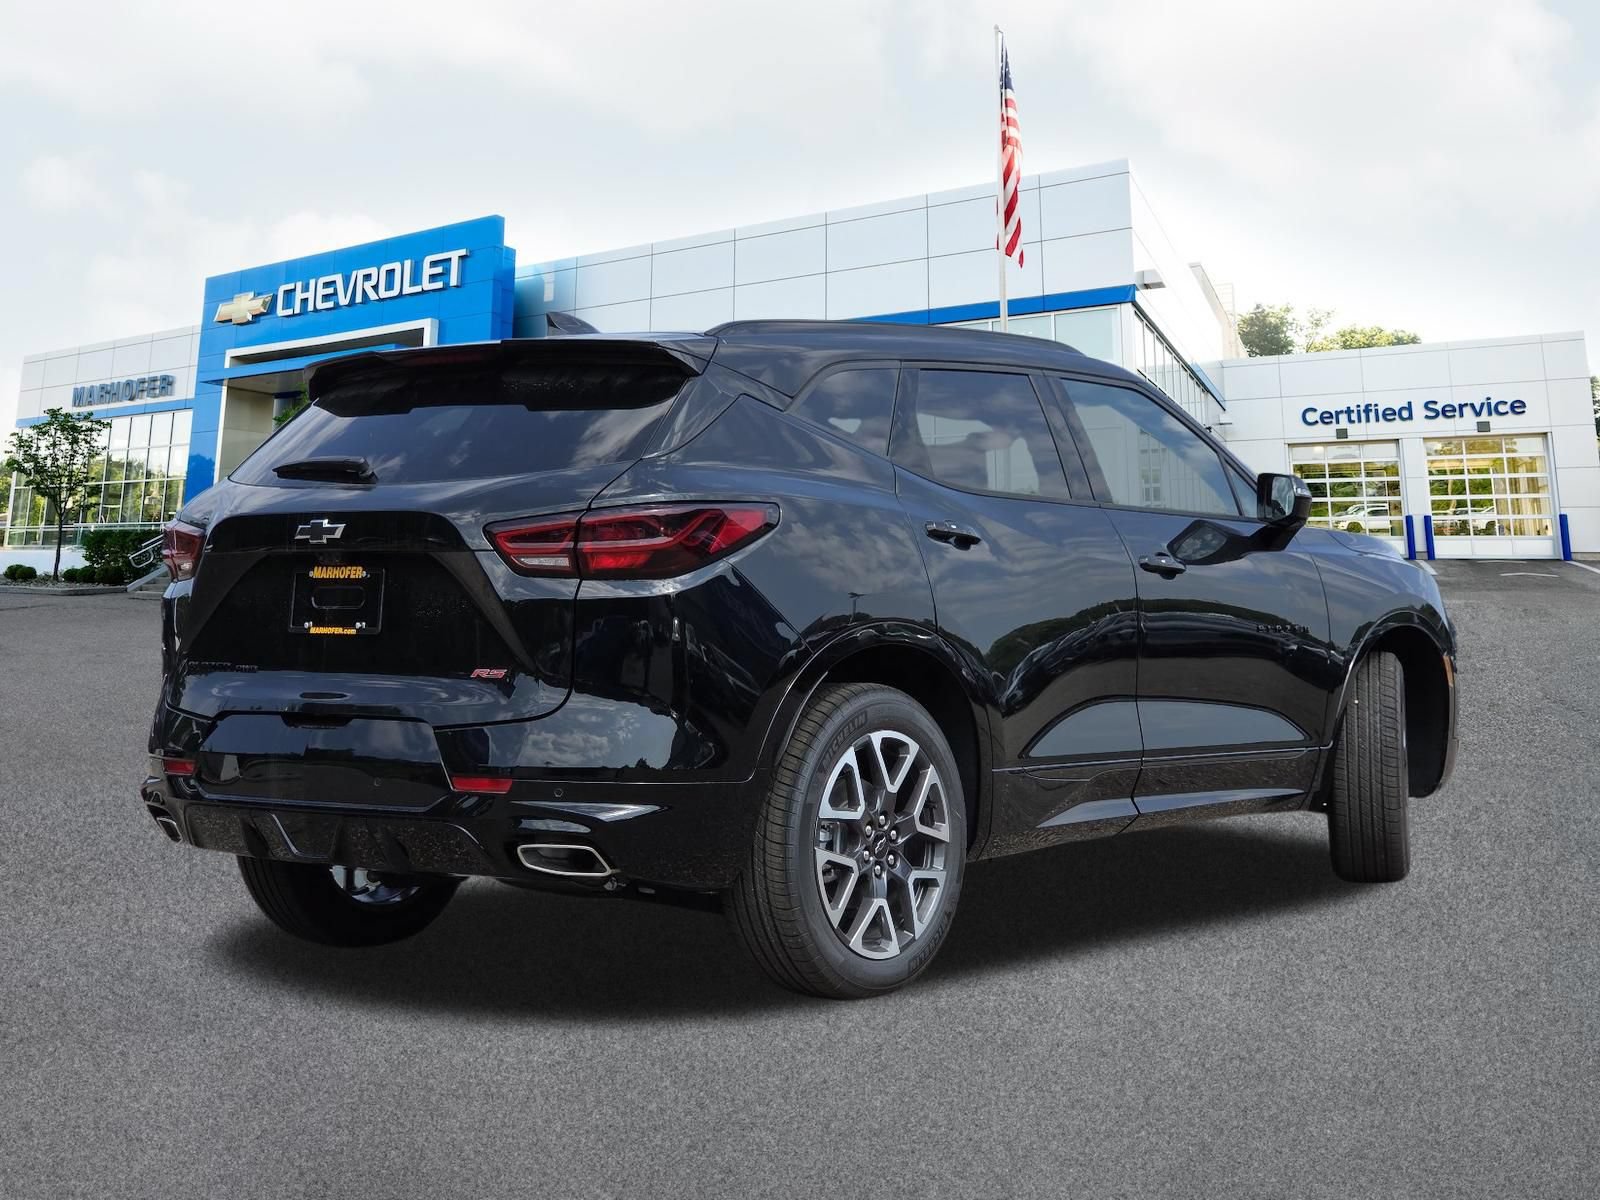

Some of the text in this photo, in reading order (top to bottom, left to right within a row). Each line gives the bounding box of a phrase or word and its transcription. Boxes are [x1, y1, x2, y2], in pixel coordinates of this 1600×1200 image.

[276, 248, 469, 317] CHEVROLET
[72, 374, 177, 407] MARHOFER
[1301, 396, 1527, 426] Certified Service
[312, 566, 363, 579] MARHOFER
[469, 668, 508, 679] RS
